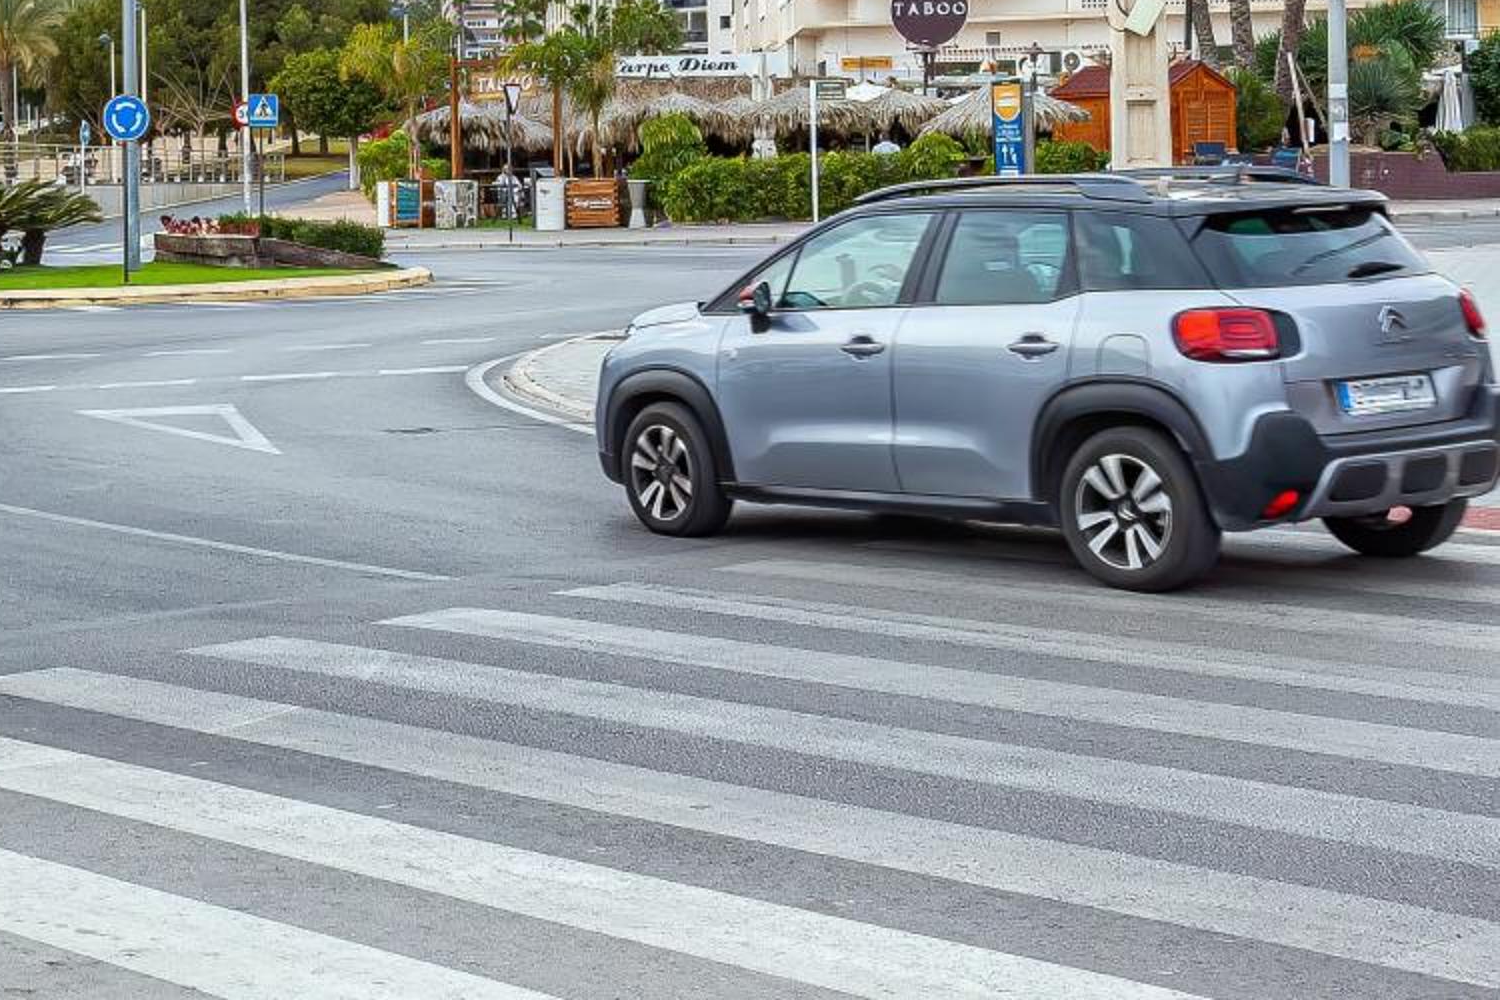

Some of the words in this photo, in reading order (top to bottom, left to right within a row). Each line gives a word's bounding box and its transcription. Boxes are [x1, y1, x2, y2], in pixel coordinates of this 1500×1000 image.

[894, 1, 966, 16] TABOO
[620, 61, 670, 77] arpe
[678, 58, 738, 71] Diem
